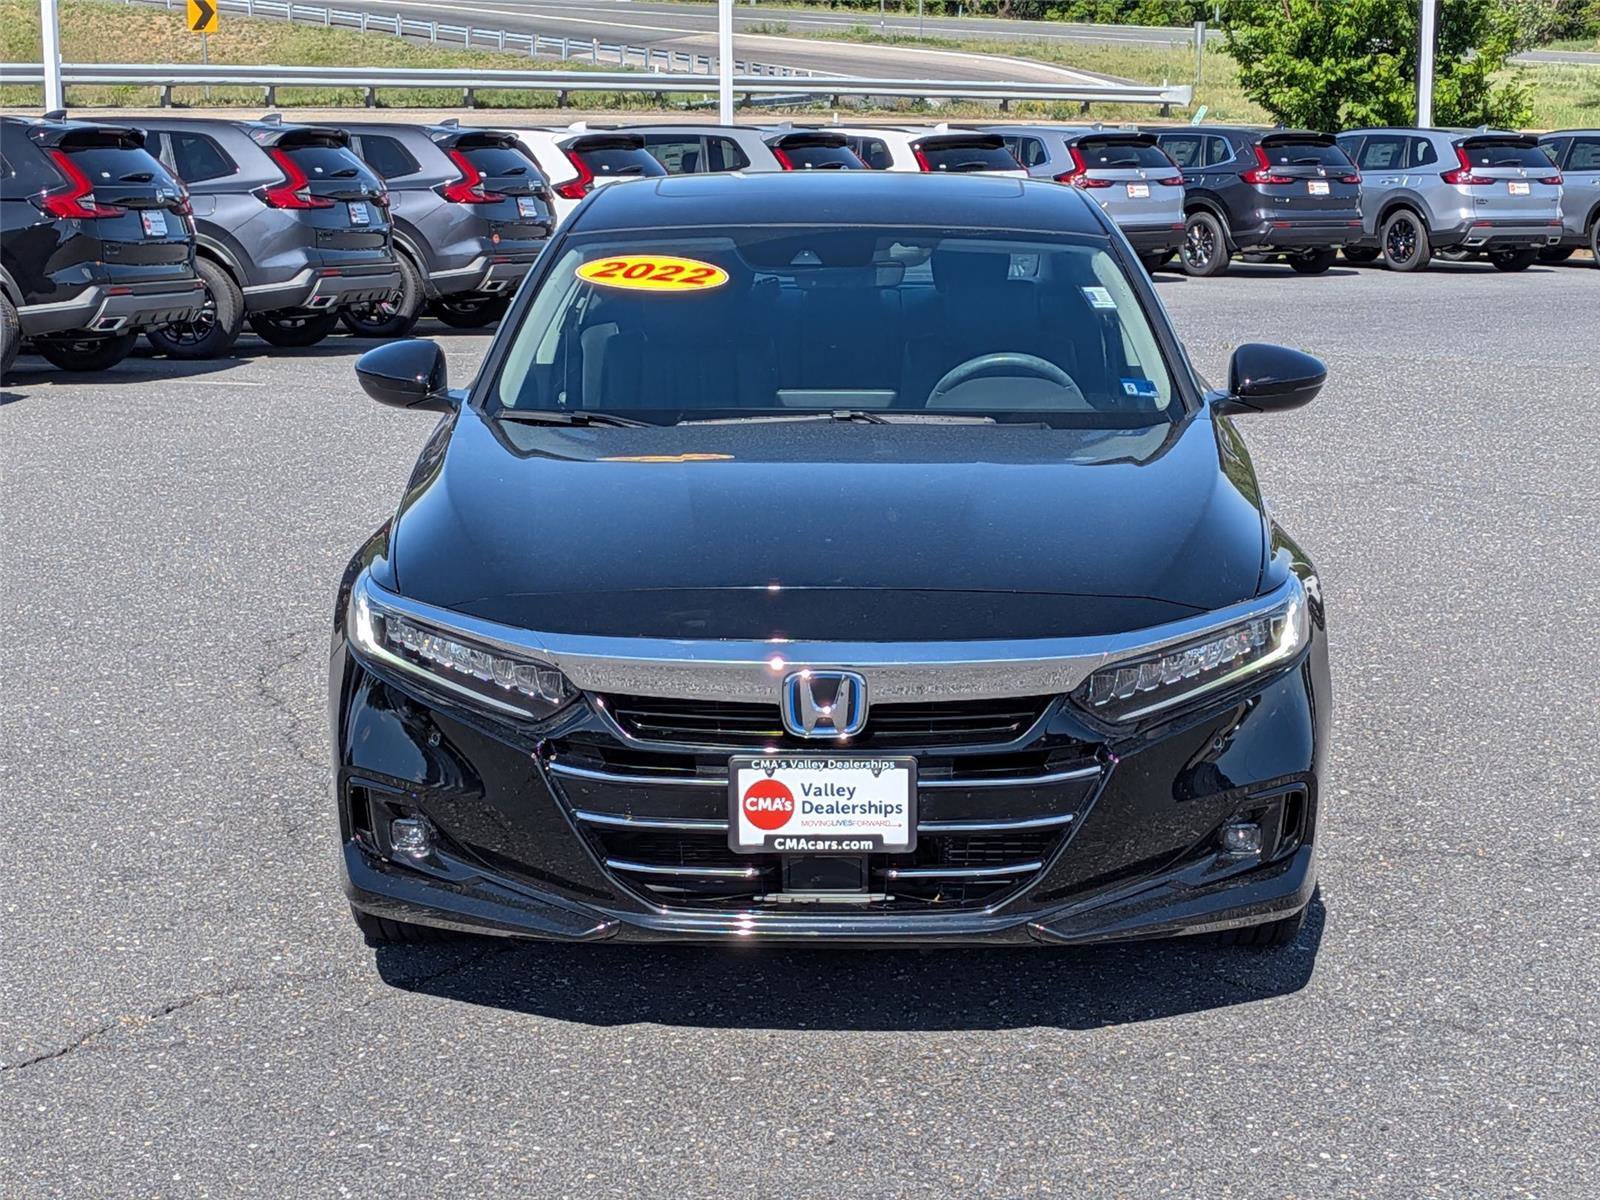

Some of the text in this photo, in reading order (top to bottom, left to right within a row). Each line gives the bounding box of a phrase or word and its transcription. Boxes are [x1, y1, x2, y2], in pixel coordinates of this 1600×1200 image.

[589, 262, 717, 285] 2022
[752, 760, 895, 770] CMA's Valley Dealerships
[801, 783, 856, 800] Valley
[745, 797, 793, 812] CMA's
[801, 800, 903, 817] Dealerships
[774, 838, 873, 850] CMAcars.com
